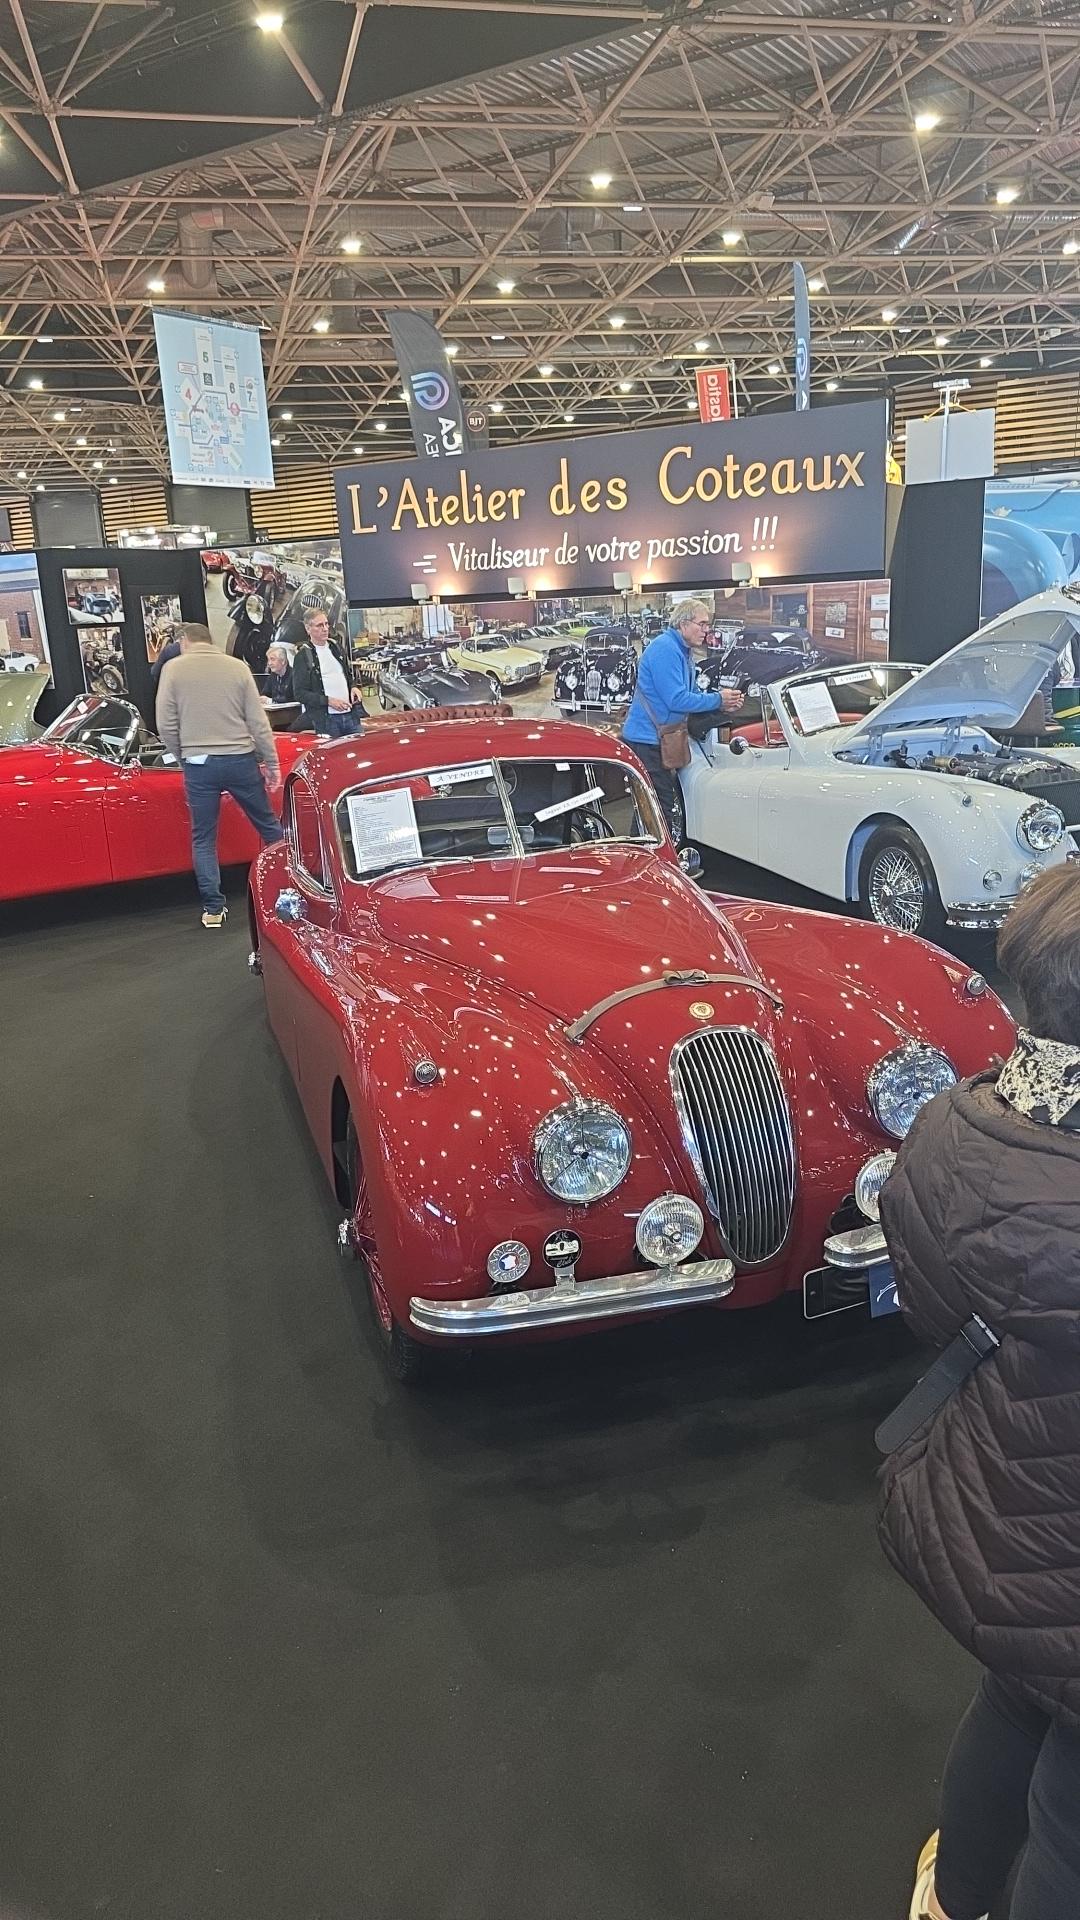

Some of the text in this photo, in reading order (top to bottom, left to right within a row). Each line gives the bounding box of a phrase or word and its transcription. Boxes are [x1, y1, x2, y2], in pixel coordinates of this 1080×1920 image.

[469, 417, 483, 426] BJT
[347, 446, 865, 534] L'Atelier des Coteaux
[447, 537, 550, 572] Vitaliseur
[554, 531, 579, 565] de
[584, 536, 642, 563] votre
[646, 529, 743, 570] passion
[448, 768, 485, 781] VENDRE
